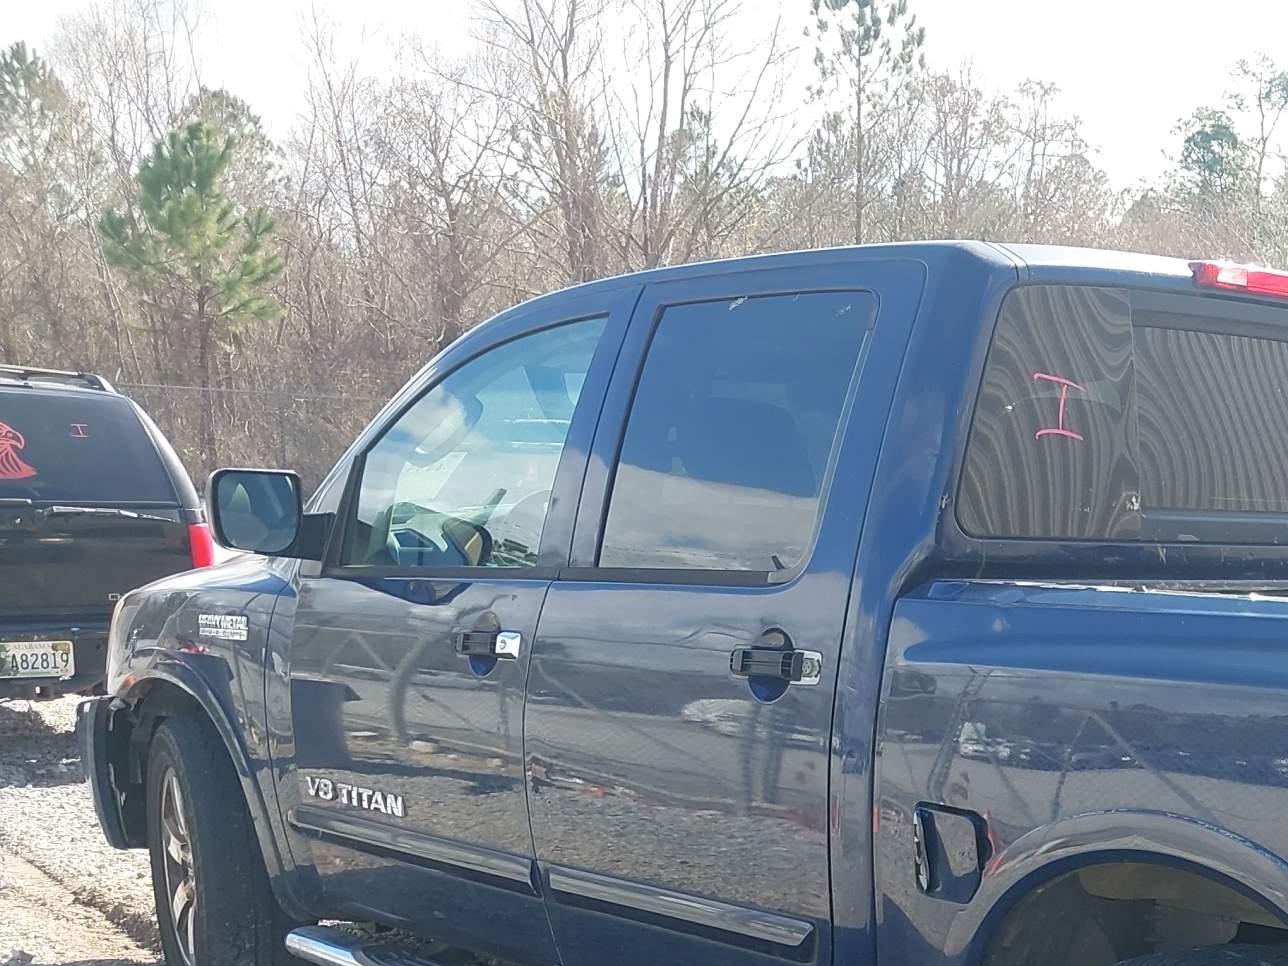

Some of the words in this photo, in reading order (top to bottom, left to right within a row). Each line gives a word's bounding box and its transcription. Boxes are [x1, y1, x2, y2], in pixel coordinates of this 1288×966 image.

[10, 652, 69, 672] A82819
[305, 775, 333, 801] V8
[336, 782, 406, 817] TITAN
